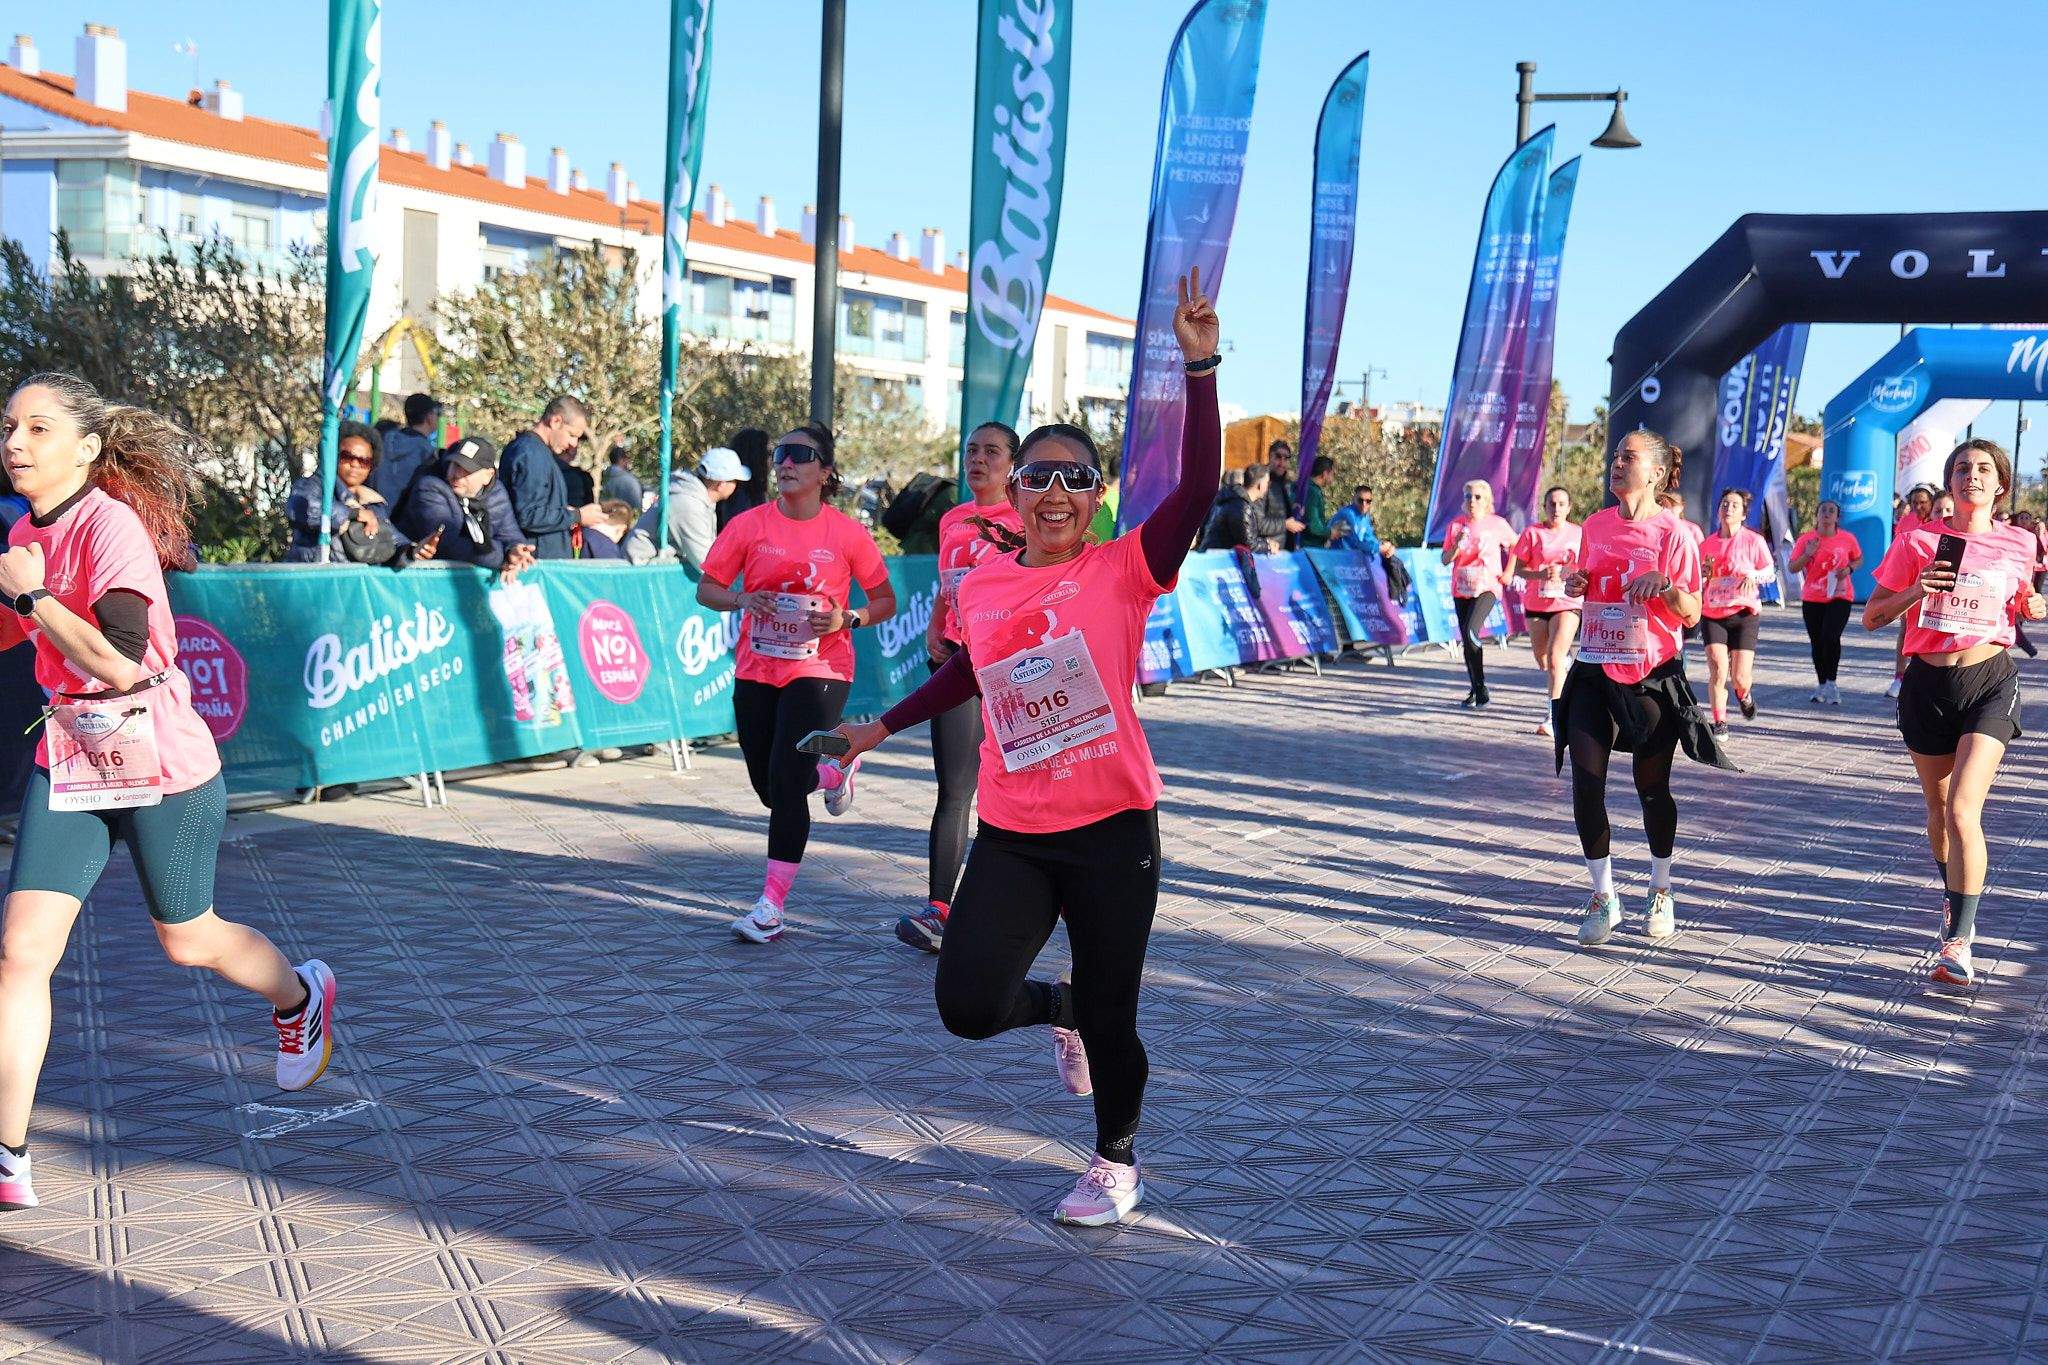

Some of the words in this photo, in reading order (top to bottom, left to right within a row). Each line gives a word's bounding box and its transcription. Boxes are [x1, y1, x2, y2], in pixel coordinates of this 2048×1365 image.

[1810, 249, 2048, 279] VOL
[1951, 596, 1979, 610] 016
[971, 608, 1012, 623] OYSHO
[772, 622, 798, 634] 016
[1601, 630, 1625, 640] 016
[180, 636, 221, 653] ARCA
[303, 601, 456, 709] Batiste
[1014, 663, 1051, 682] ASTURIANA
[321, 692, 389, 747] CHAMPÚ
[394, 682, 415, 707] EN
[419, 656, 463, 693] SECO
[1025, 689, 1069, 719] 016
[1017, 742, 1051, 760] OYSHO
[1072, 722, 1106, 740] Santander
[88, 751, 124, 767] 016
[1063, 753, 1078, 765] LA
[1080, 741, 1119, 761] MUJER
[1053, 768, 1073, 781] 2025
[65, 795, 101, 804] OYSHO
